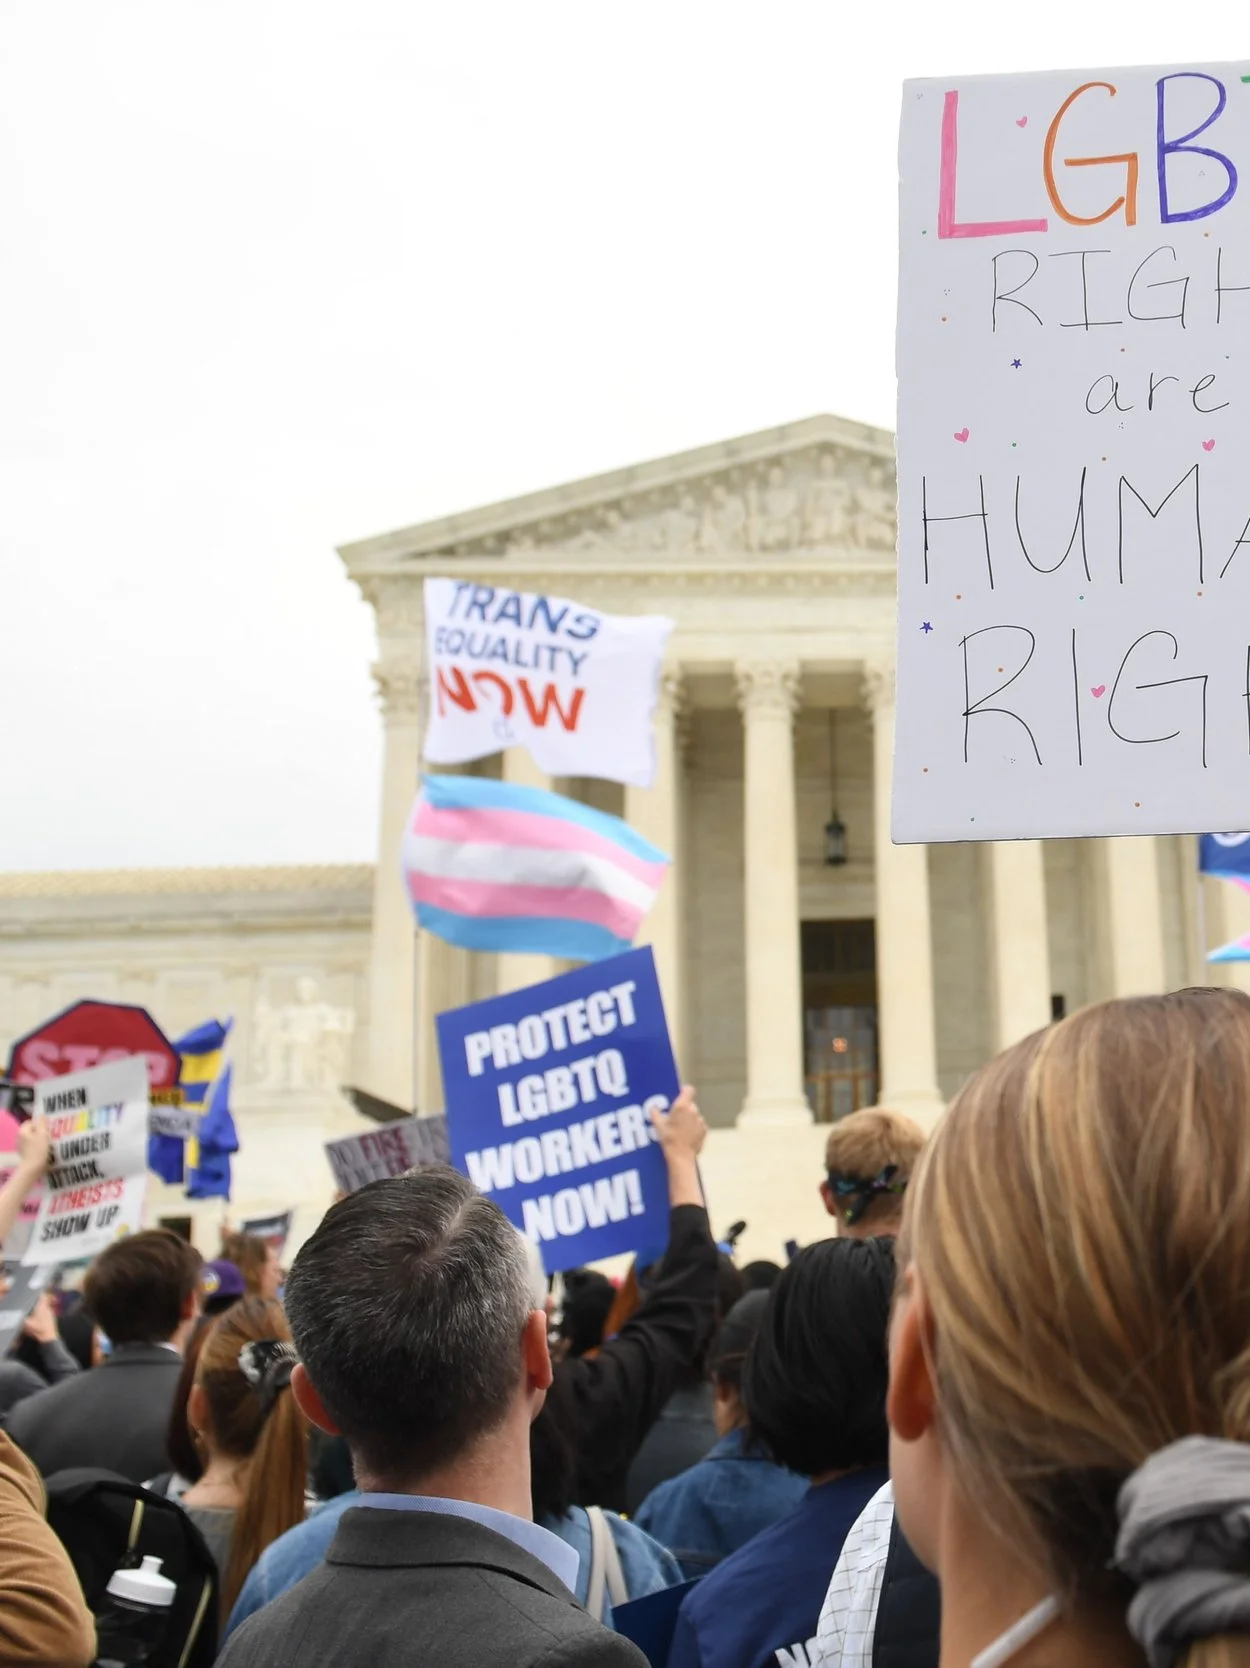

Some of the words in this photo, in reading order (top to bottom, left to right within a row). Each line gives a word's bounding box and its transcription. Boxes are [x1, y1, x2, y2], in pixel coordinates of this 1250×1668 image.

[1086, 372, 1230, 415] are
[448, 580, 601, 640] TRANS
[435, 626, 588, 677] EQUALITY
[436, 664, 586, 732] NOW
[464, 980, 637, 1078] PROTECT
[43, 1088, 87, 1112] WHEN
[497, 1048, 630, 1127] LGBTQ
[60, 1132, 112, 1161] UNDER
[41, 1211, 92, 1242] SHOW
[96, 1205, 120, 1229] UP
[521, 1167, 645, 1244] NOW!
